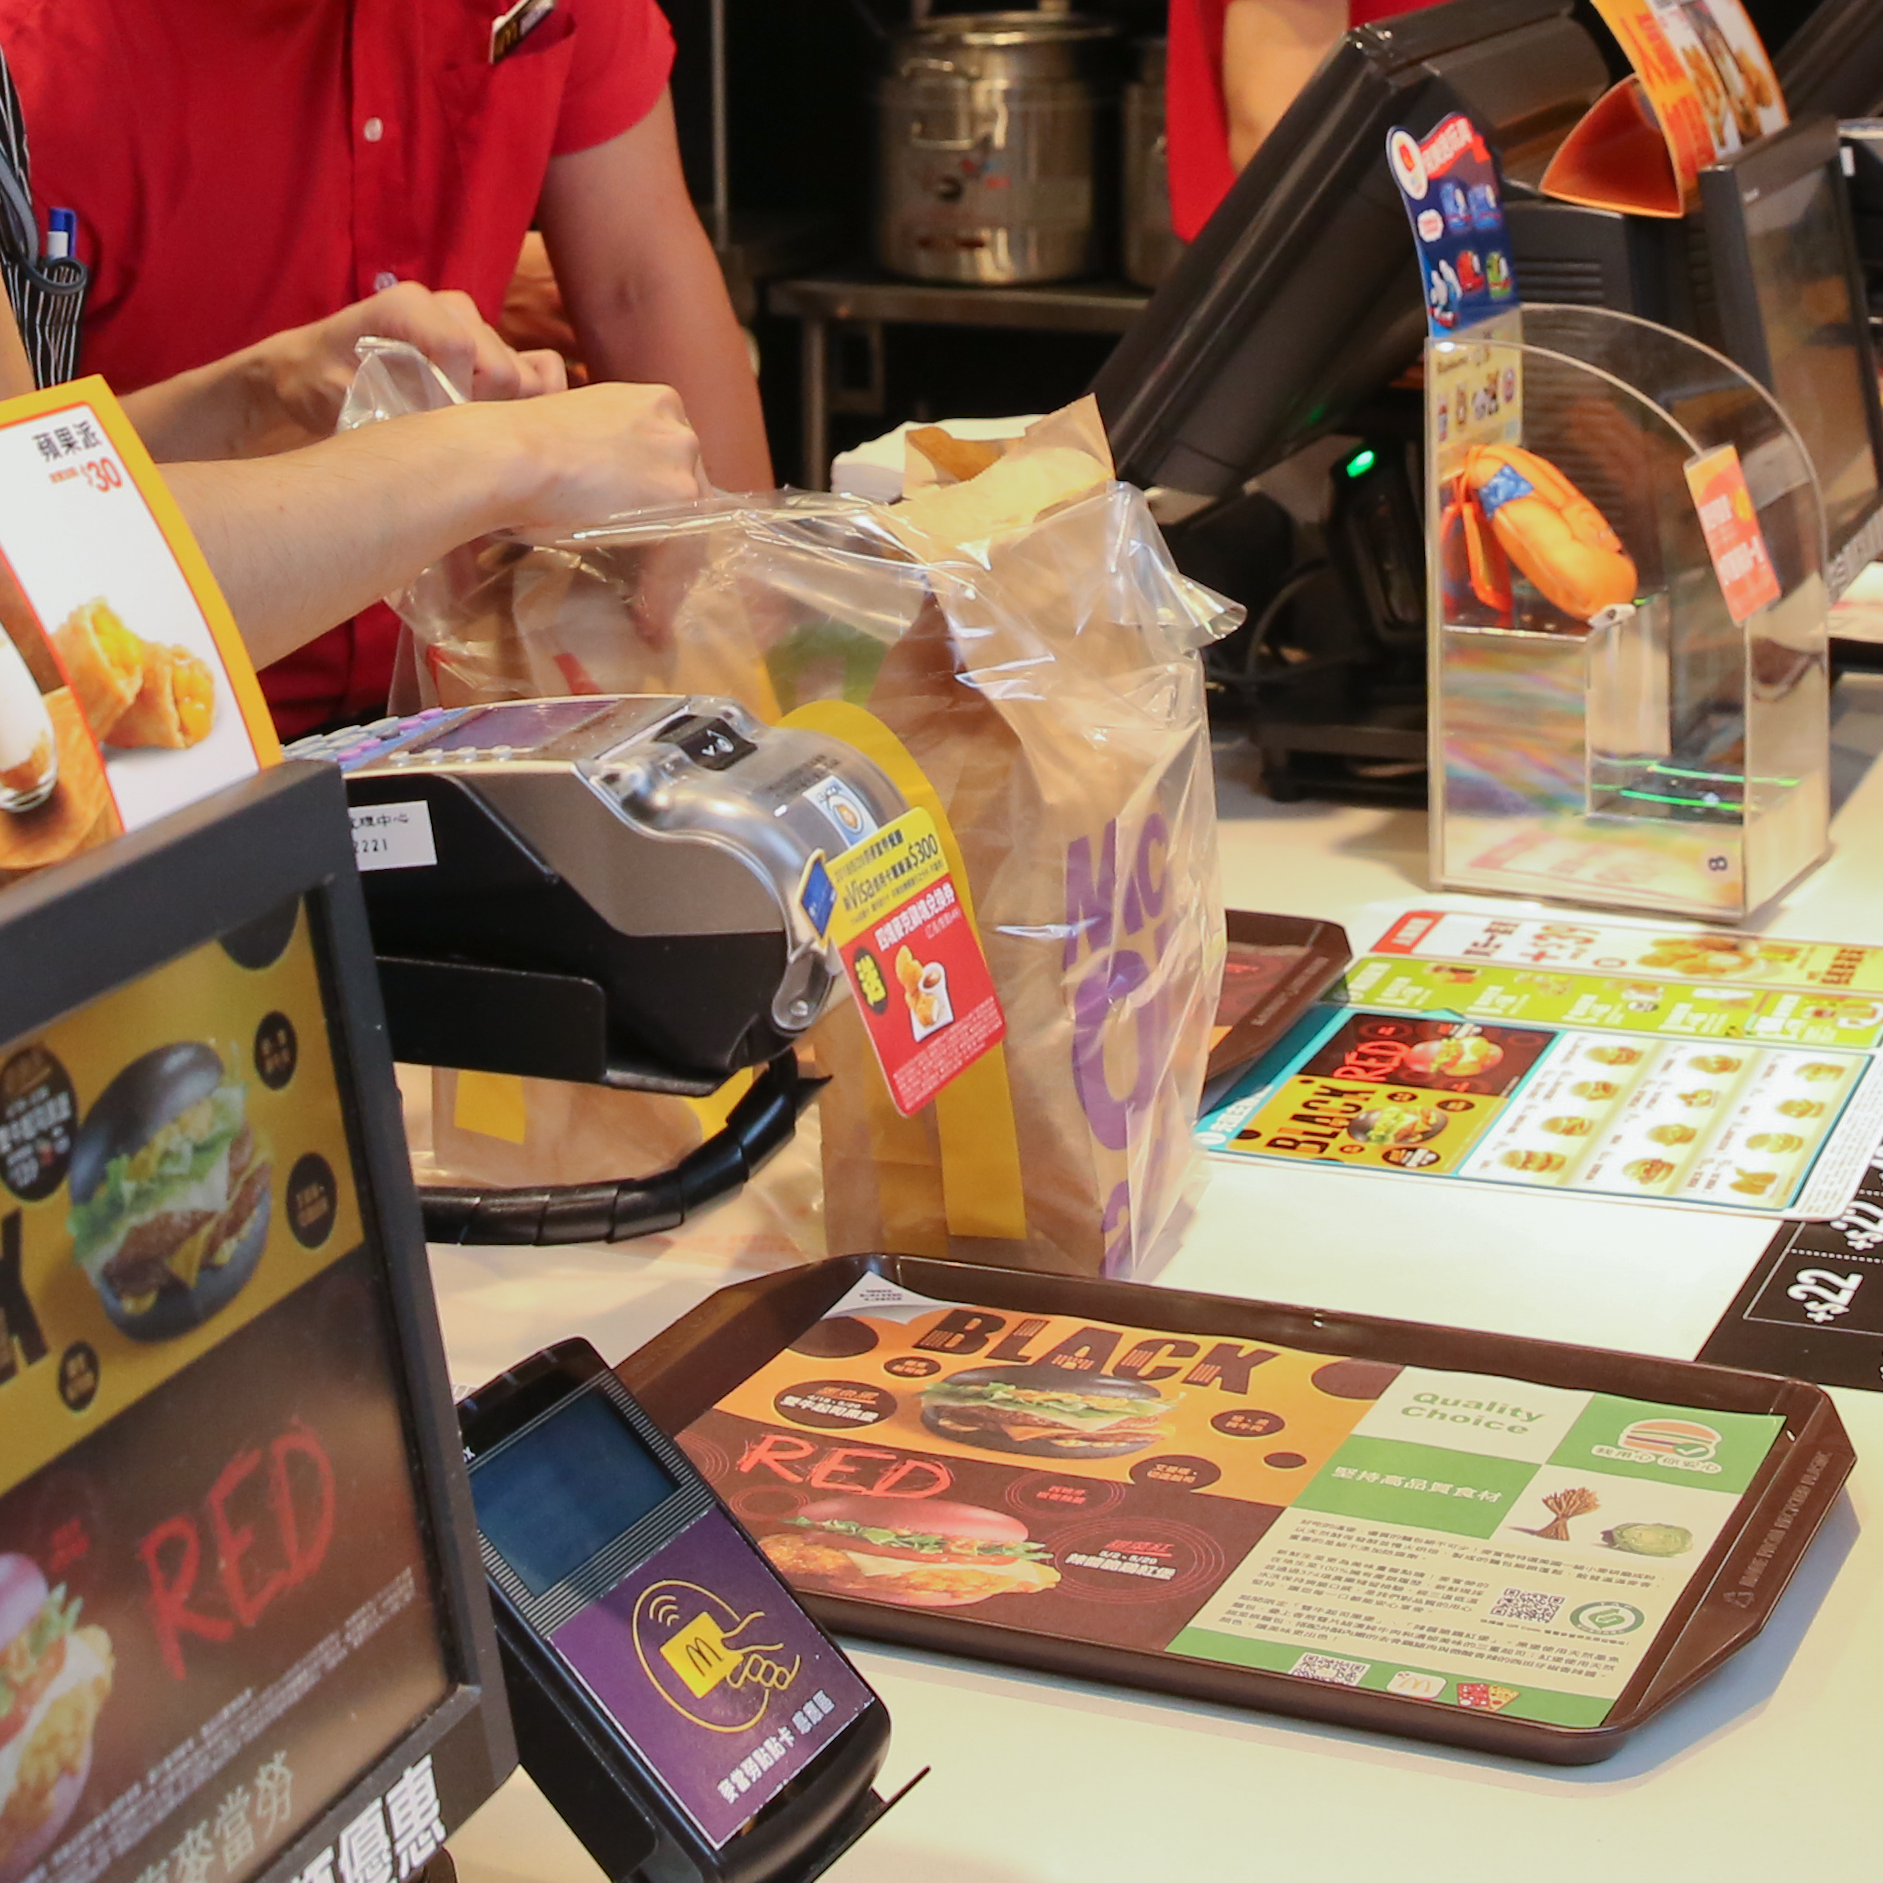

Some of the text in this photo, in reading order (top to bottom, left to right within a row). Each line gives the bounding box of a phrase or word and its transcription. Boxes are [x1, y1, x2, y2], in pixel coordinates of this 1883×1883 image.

[32, 419, 102, 463] 蘋果派
[80, 457, 122, 492] $30
[1331, 1039, 1413, 1084] RED
[1264, 1082, 1378, 1155] BLACK
[1786, 1266, 1864, 1324] +$22
[912, 1309, 1279, 1396] BLACK
[1399, 1404, 1530, 1436] Choice
[1413, 1390, 1546, 1425] Quality
[738, 1433, 952, 1500] RED
[1330, 1465, 1504, 1505] 堅持高品質食材
[137, 1413, 338, 1680] RED
[717, 1689, 837, 1805] 麥當勞點點卡 感應區
